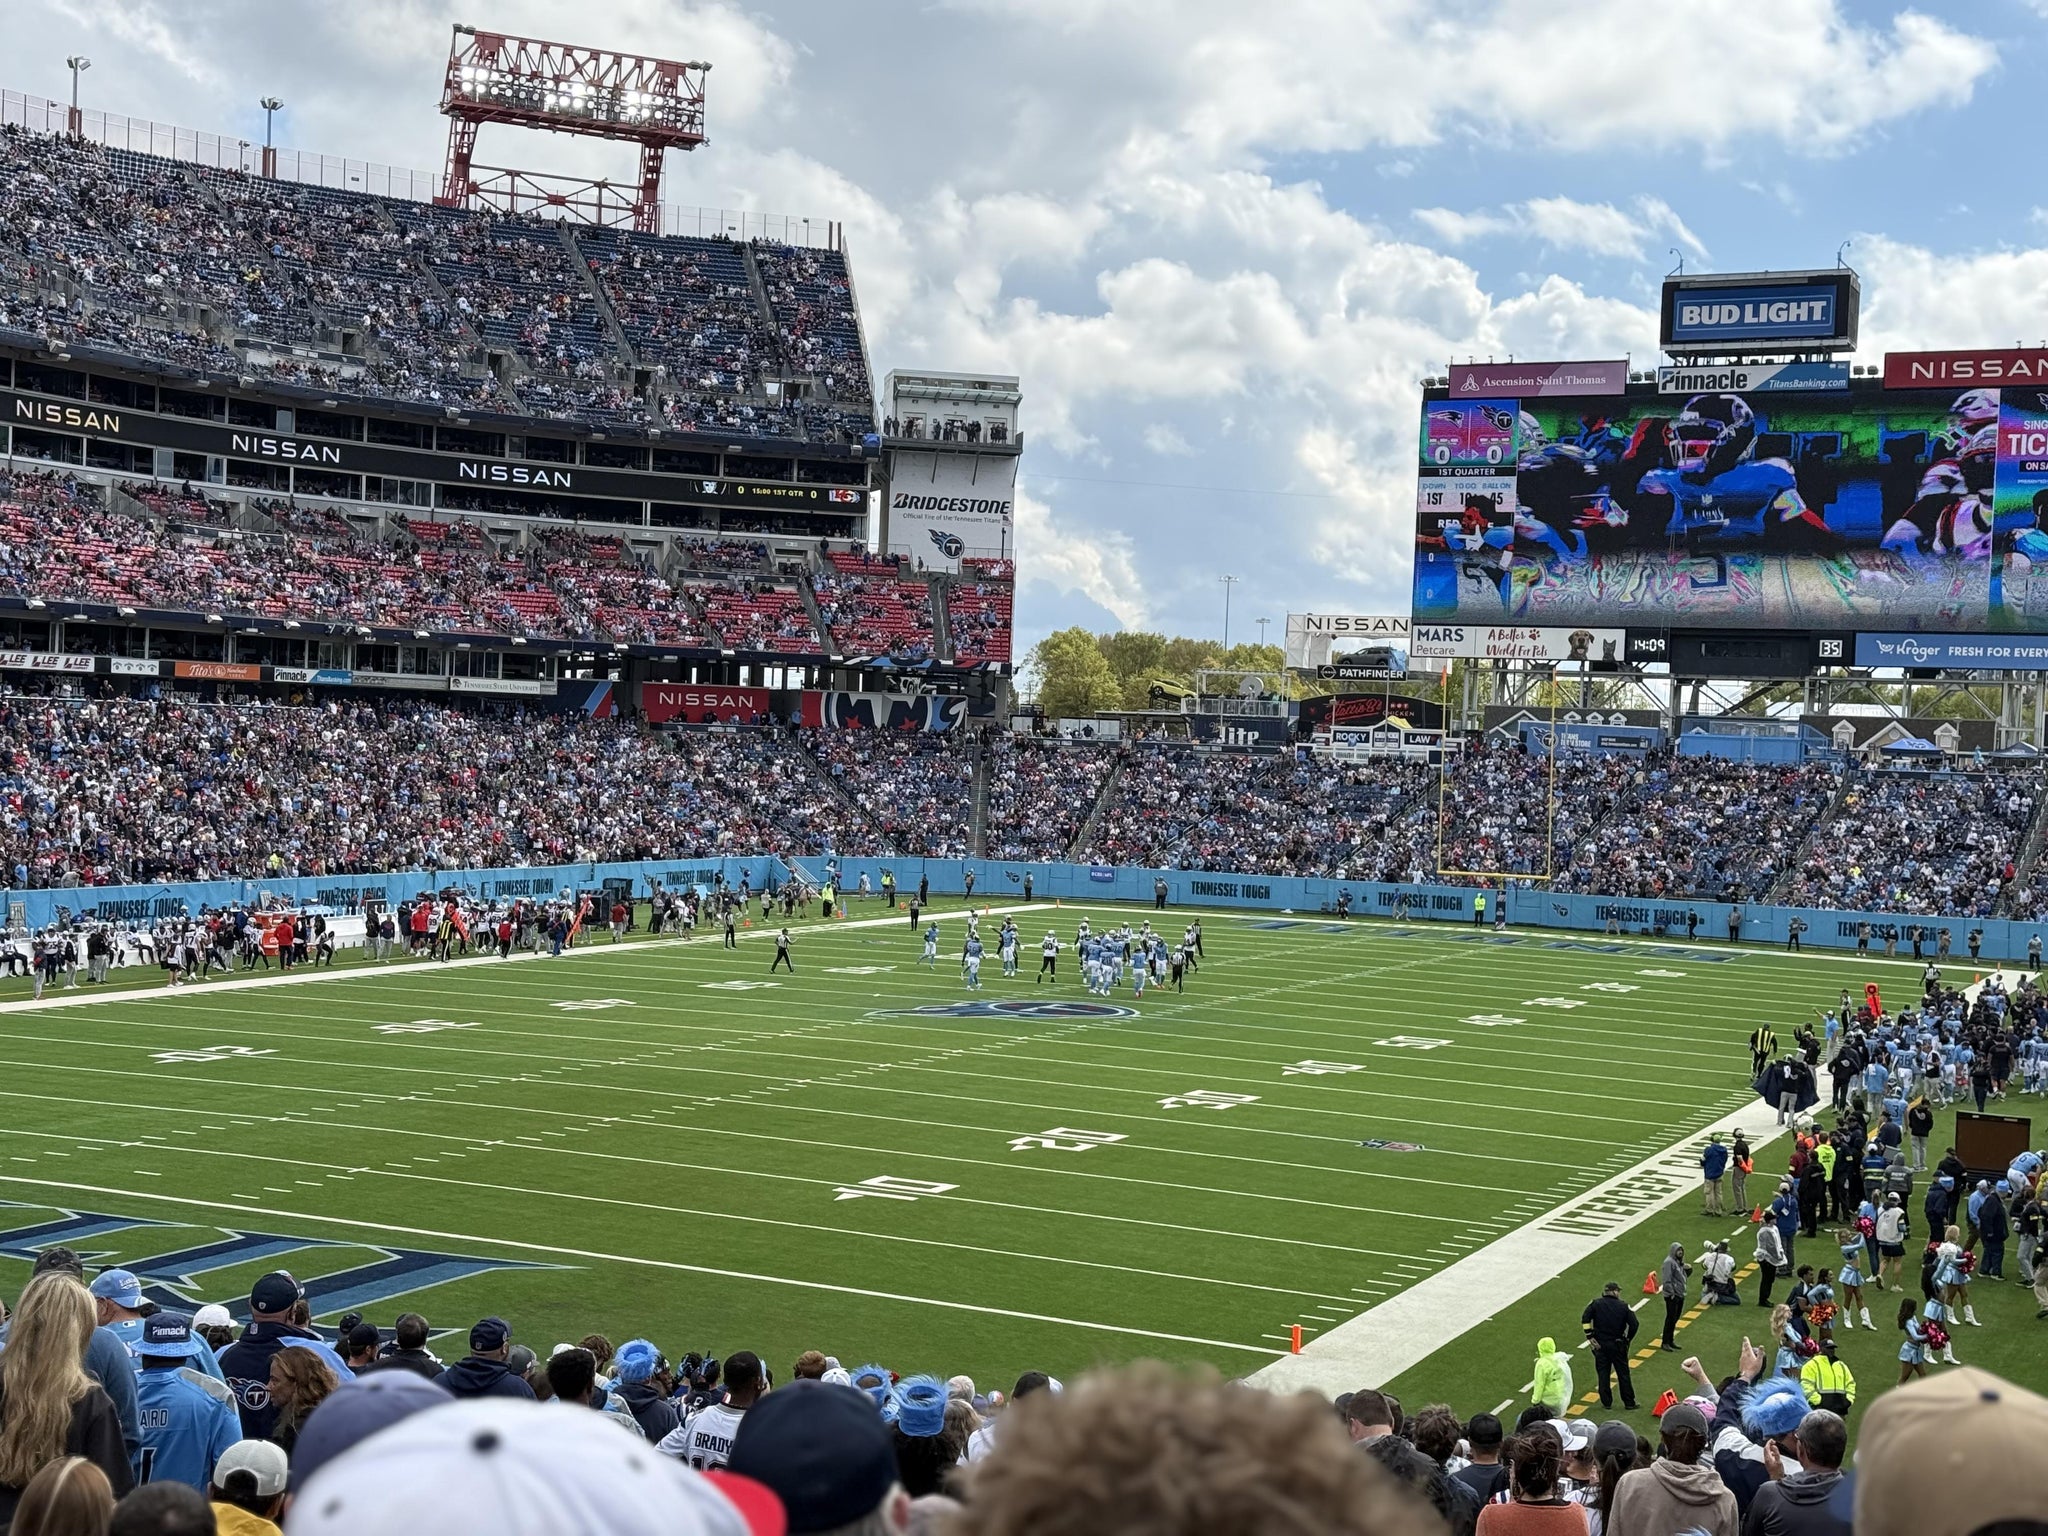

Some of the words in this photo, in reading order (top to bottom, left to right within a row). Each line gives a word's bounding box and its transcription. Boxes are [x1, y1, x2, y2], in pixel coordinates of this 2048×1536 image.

[1681, 304, 1741, 326] BUD
[1744, 301, 1827, 324] LIGHT
[1483, 377, 1534, 387] Ascension
[1536, 376, 1563, 386] Saint
[1565, 375, 1606, 385] Thomas
[1661, 369, 1748, 391] Pinnacle
[1769, 379, 1847, 390] TitansBanking.com
[16, 399, 120, 433] NISSAN
[232, 433, 341, 464] NISSAN
[2008, 433, 2048, 456] TIC
[1435, 445, 1451, 465] 0
[1486, 445, 1502, 465] 0
[1439, 468, 1452, 476] 1ST
[1454, 468, 1496, 476] QUARTER
[2025, 462, 2039, 471] ON
[459, 462, 572, 488] NISSAN
[737, 486, 745, 494] 0
[810, 490, 818, 499] 0
[893, 493, 1011, 514] BRIDGESTONE
[1427, 492, 1443, 505] 1ST
[1306, 617, 1409, 632] NISSAN
[1416, 627, 1465, 642] MARS
[1487, 629, 1497, 641] A
[1498, 628, 1526, 641] Better
[1416, 644, 1456, 656] Petcare
[1486, 643, 1515, 657] World
[1517, 645, 1530, 657] For
[1532, 645, 1548, 657] Pets
[1634, 638, 1666, 651] 14:09
[1823, 641, 1840, 656] 35
[1896, 639, 1941, 663] Kroger
[1949, 646, 1984, 657] FRESH
[1987, 647, 2011, 657] FOR
[9, 654, 27, 663] LEE
[42, 656, 59, 665] LEE
[73, 657, 91, 666] LEE
[188, 663, 214, 677] Tito's
[275, 669, 307, 682] Pinnacle
[1339, 669, 1404, 679] PATHFINDER
[658, 692, 753, 708] NISSAN
[1336, 732, 1367, 741] ROCKY
[1409, 735, 1431, 744] LAW
[495, 879, 530, 896] TENNESSEE
[1191, 881, 1238, 897] TENNESSEE
[1241, 884, 1270, 900] TOUGH
[1432, 895, 1462, 910] TOUGH
[1156, 1089, 1262, 1110] 30
[1007, 1126, 1130, 1152] 20
[832, 1175, 961, 1201] 10
[1537, 1168, 1697, 1237] INTERCEPT
[694, 1431, 734, 1455] BRADY
